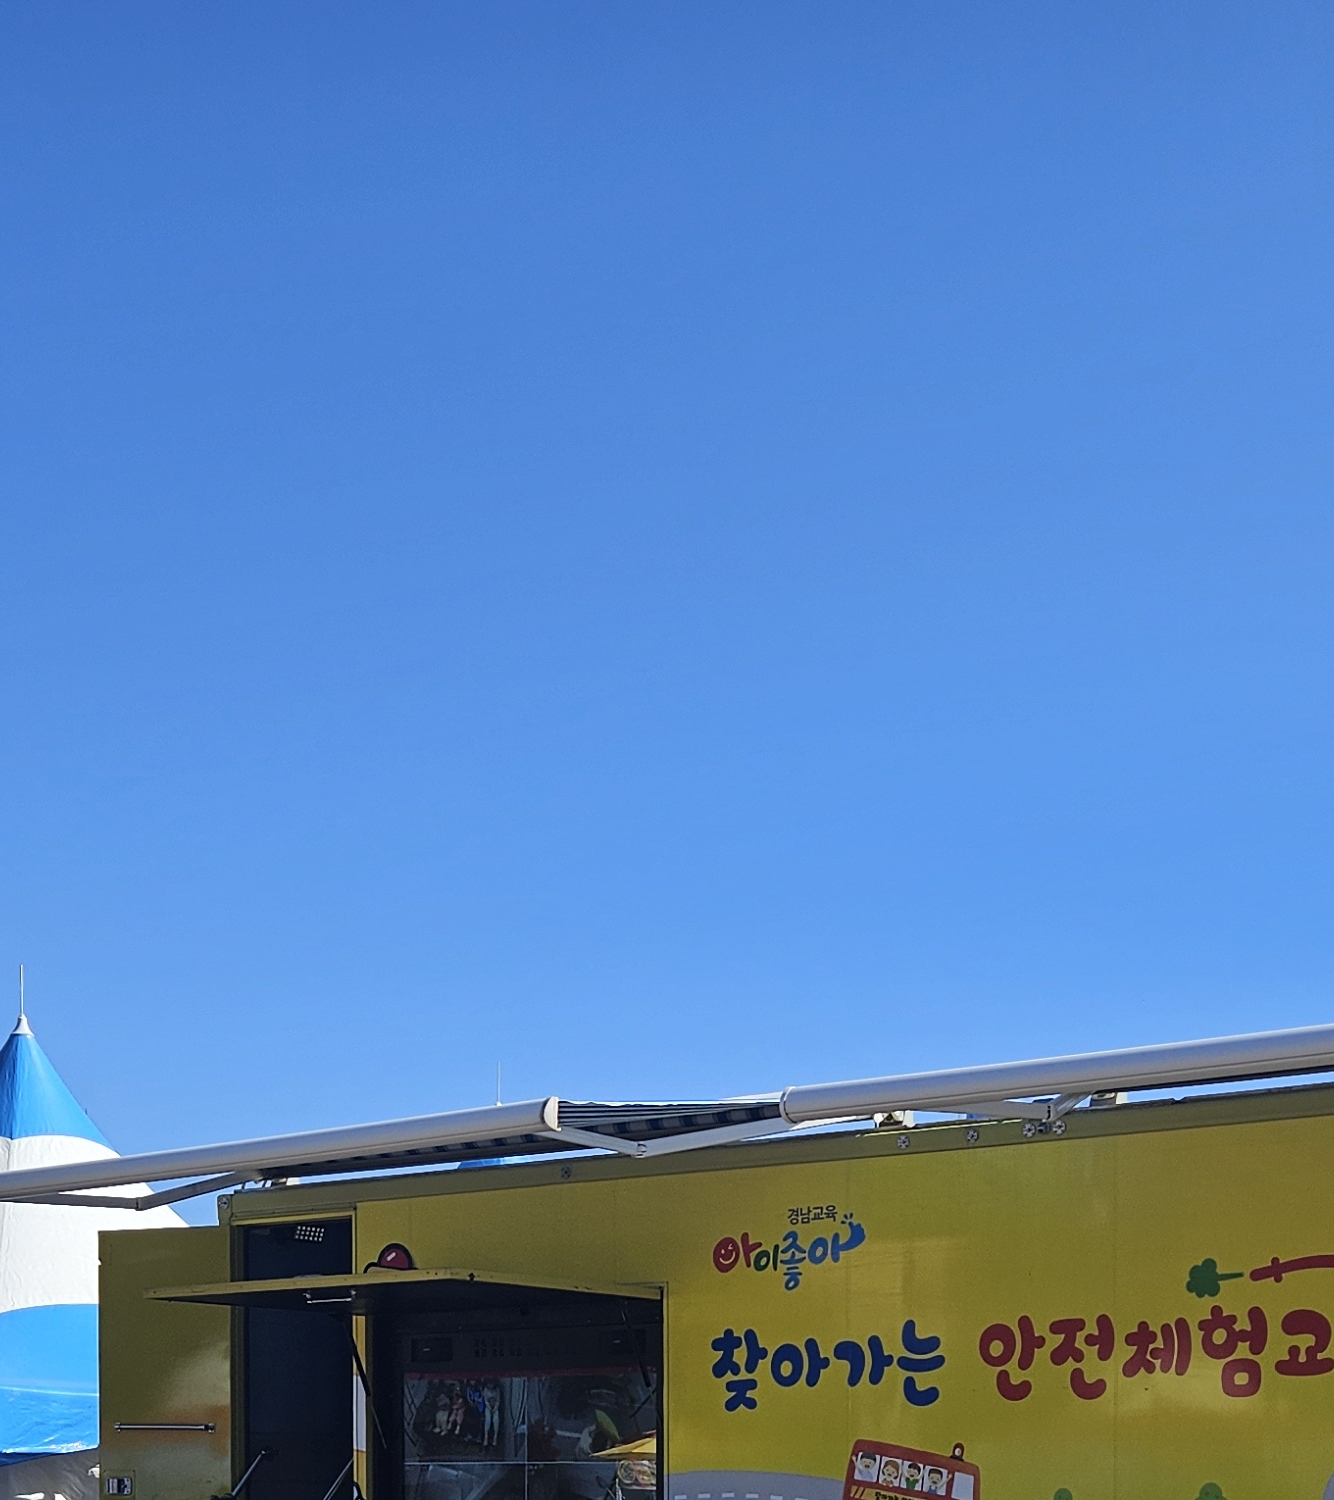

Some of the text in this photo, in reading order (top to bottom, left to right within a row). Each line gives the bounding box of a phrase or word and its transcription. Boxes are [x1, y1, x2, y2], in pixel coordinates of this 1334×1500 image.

[787, 1204, 838, 1225] 경남교육
[712, 1222, 866, 1291] 아이좋아
[710, 1319, 946, 1412] 찾아가는
